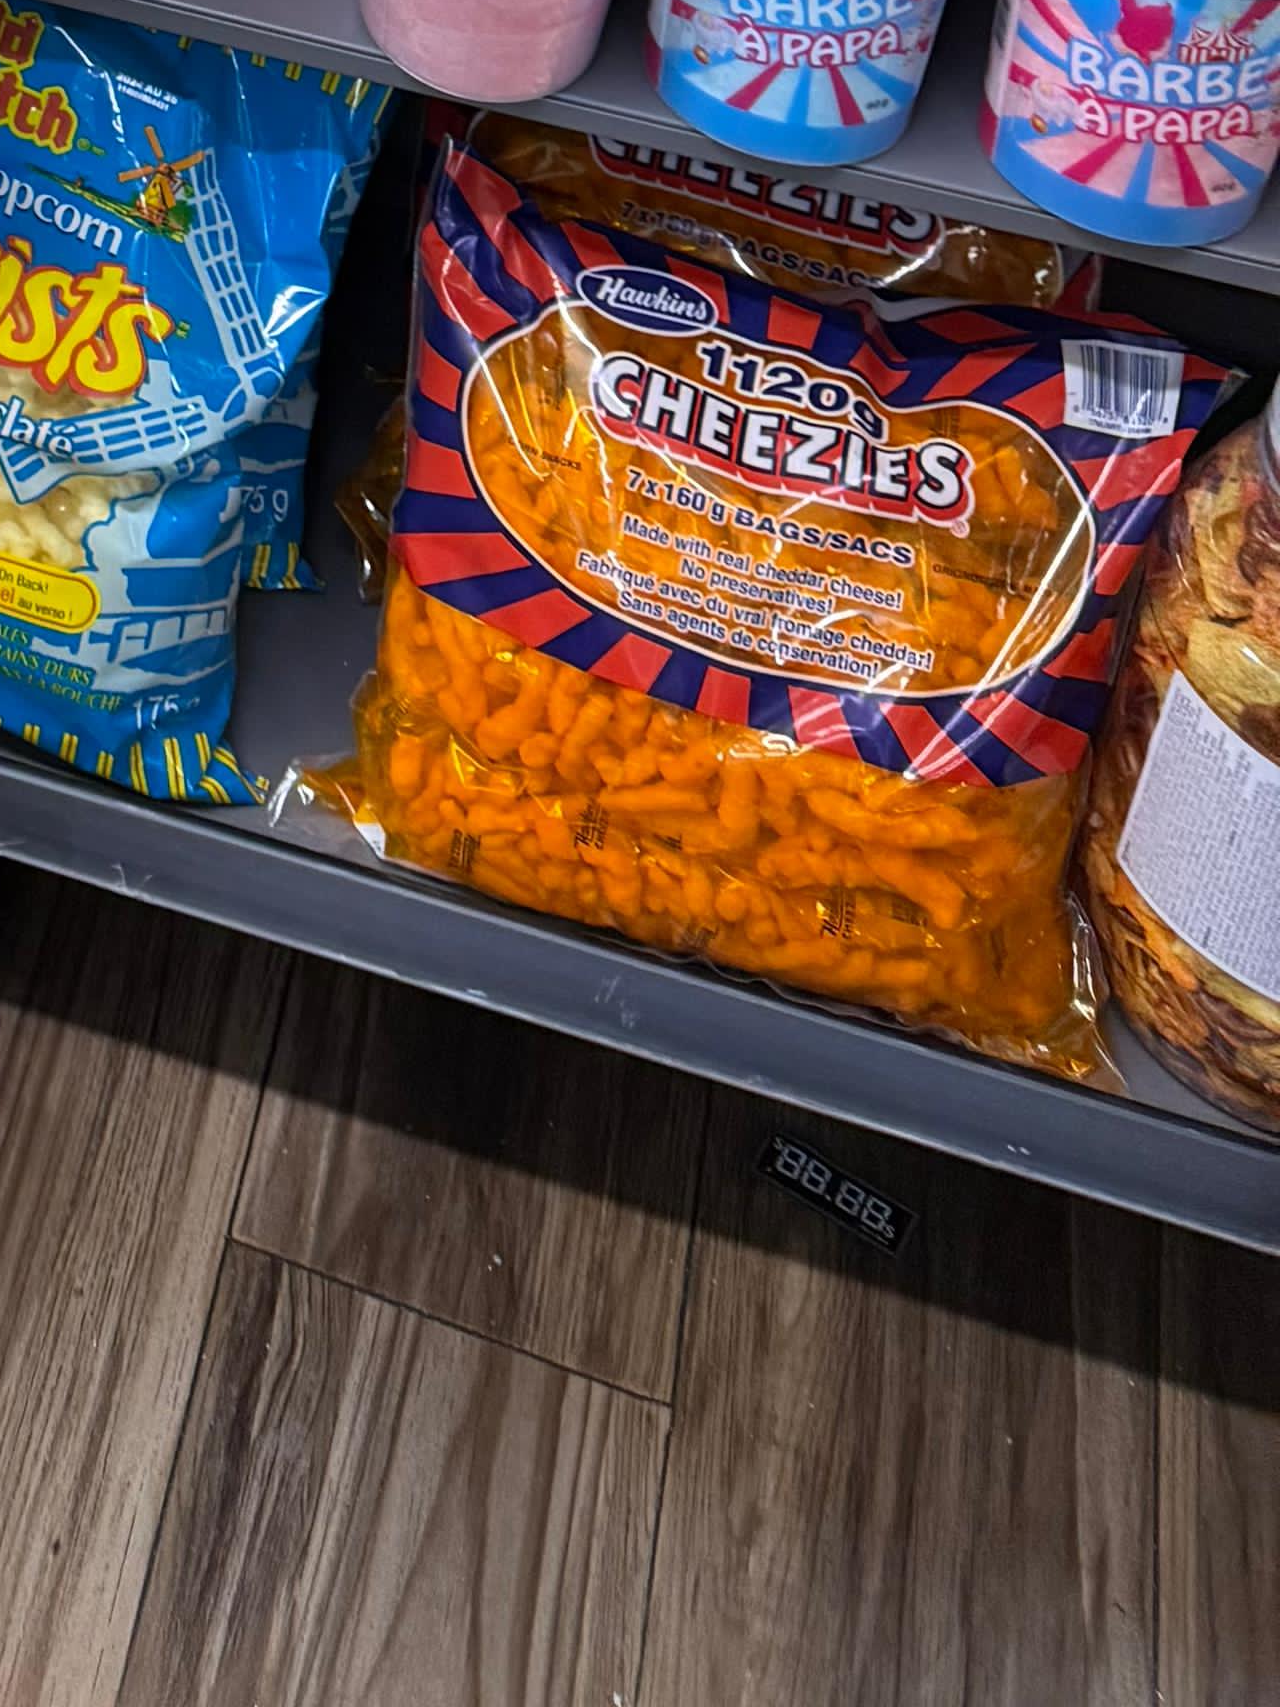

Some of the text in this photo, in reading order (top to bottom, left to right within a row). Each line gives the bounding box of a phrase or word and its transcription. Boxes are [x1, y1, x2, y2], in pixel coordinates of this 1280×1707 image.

[594, 274, 709, 322] Hawkins
[595, 354, 969, 515] CHEEZIES
[697, 340, 890, 442] 1120g
[623, 516, 903, 611] Made with real cheddar cheese!
[734, 508, 914, 566] BAGS/SACS
